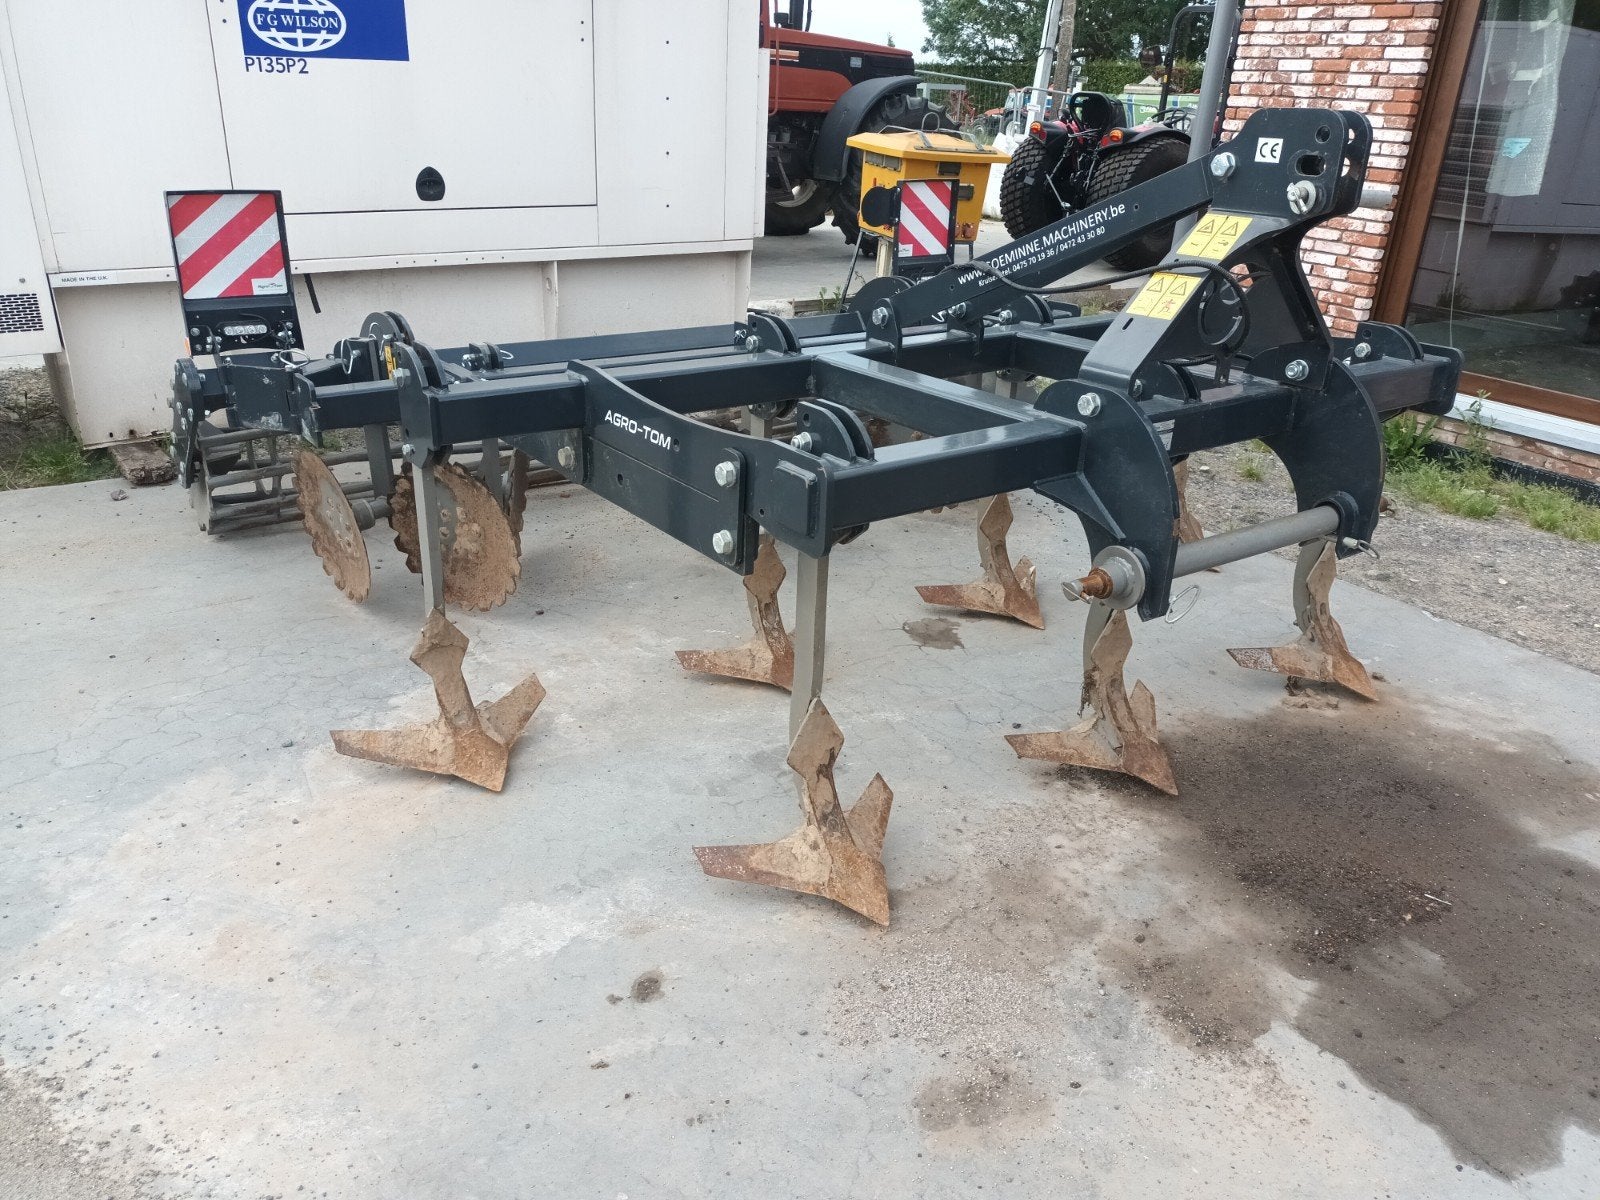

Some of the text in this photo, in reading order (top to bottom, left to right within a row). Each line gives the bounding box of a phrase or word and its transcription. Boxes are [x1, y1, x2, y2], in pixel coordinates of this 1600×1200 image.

[280, 14, 339, 28] WILSON
[244, 56, 309, 74] P135P2
[1260, 142, 1280, 159] CE
[957, 203, 1126, 286] www.OEMINNE.MACHINERY.be
[1012, 260, 1028, 272] 0475
[1029, 256, 1037, 265] 70
[1037, 252, 1046, 261] 19
[1046, 248, 1055, 258] 36
[1059, 239, 1076, 252] 0472
[1077, 234, 1086, 244] 43
[1087, 230, 1095, 240] 30
[1096, 226, 1105, 236] 80
[604, 409, 672, 450] AGRO-TOM
